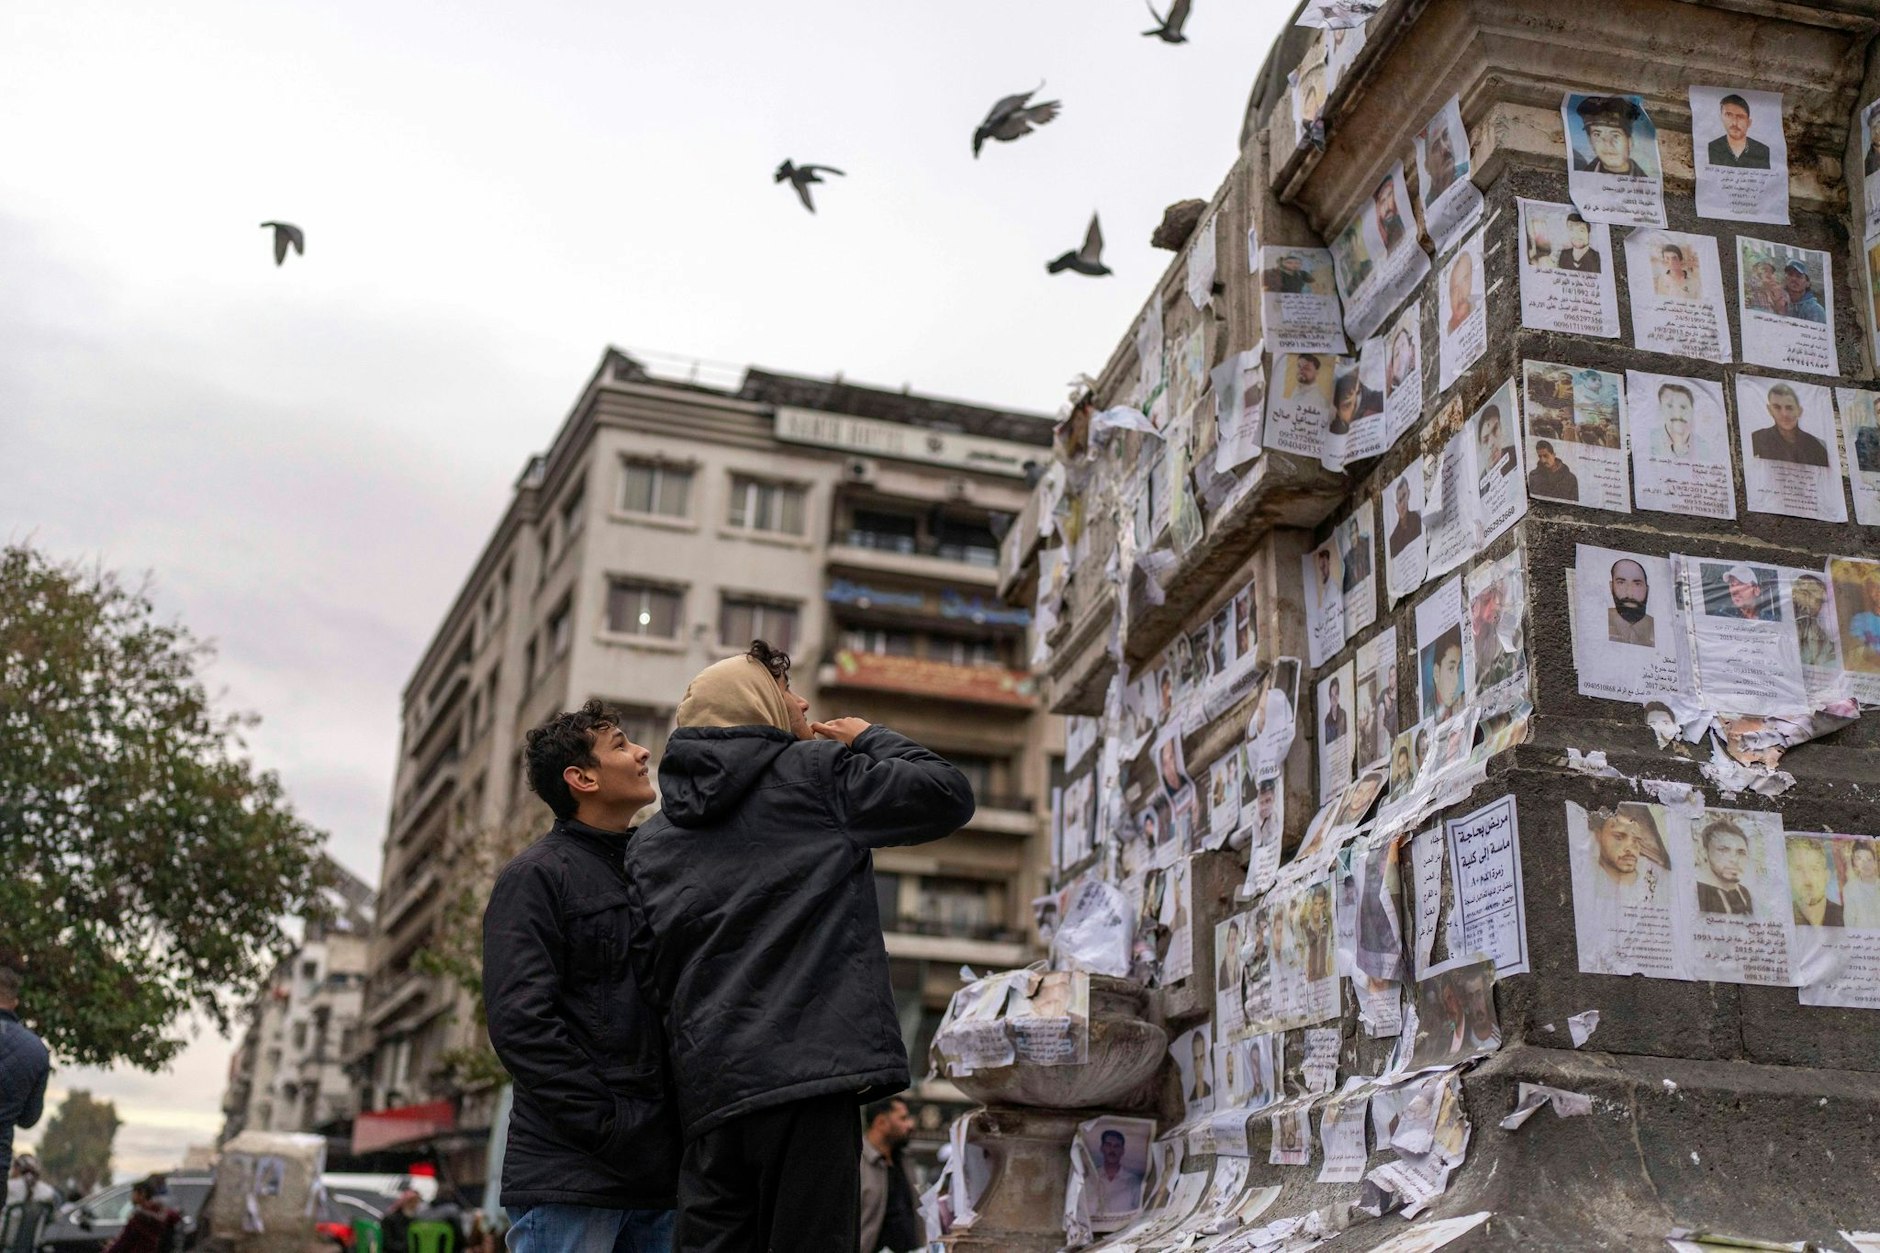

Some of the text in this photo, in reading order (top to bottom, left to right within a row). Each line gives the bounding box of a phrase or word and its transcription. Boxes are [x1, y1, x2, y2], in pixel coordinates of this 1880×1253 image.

[1296, 404, 1321, 416] مفقود
[1458, 814, 1508, 844] مريض بحاجة
[1460, 837, 1510, 870] ماسة إلى كلية
[1480, 870, 1491, 886] الدم
[1491, 864, 1505, 880] زمرة
[1693, 933, 1712, 941] 1993
